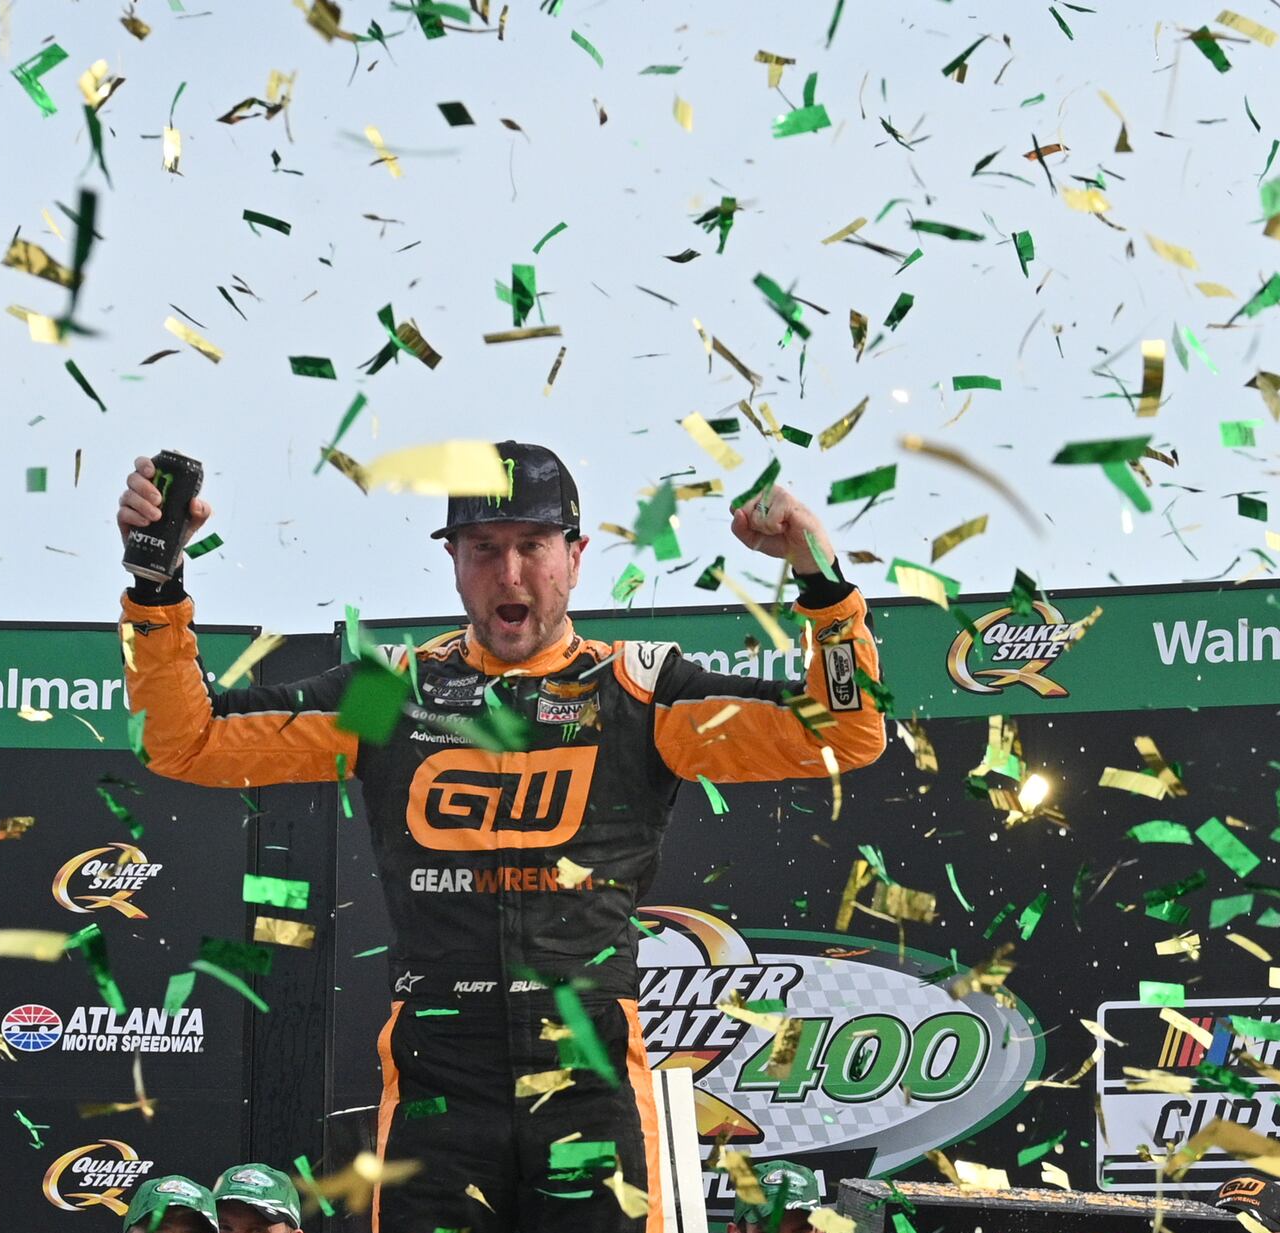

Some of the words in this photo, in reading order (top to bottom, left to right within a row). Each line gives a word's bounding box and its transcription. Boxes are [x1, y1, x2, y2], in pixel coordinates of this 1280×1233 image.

[682, 638, 803, 681] mart
[991, 638, 1066, 661] STATE
[81, 860, 163, 881] QUAKER
[88, 873, 147, 891] STATE
[453, 981, 498, 993] KURT
[640, 966, 792, 1006] AKER
[62, 1007, 205, 1037] ATLANTA
[637, 1010, 742, 1047] ATE
[61, 1034, 117, 1051] MOTOR
[120, 1035, 203, 1053] SPEEDWAY
[734, 1011, 991, 1104] 400
[71, 1156, 154, 1176] QUAKER
[79, 1172, 138, 1189] STATE
